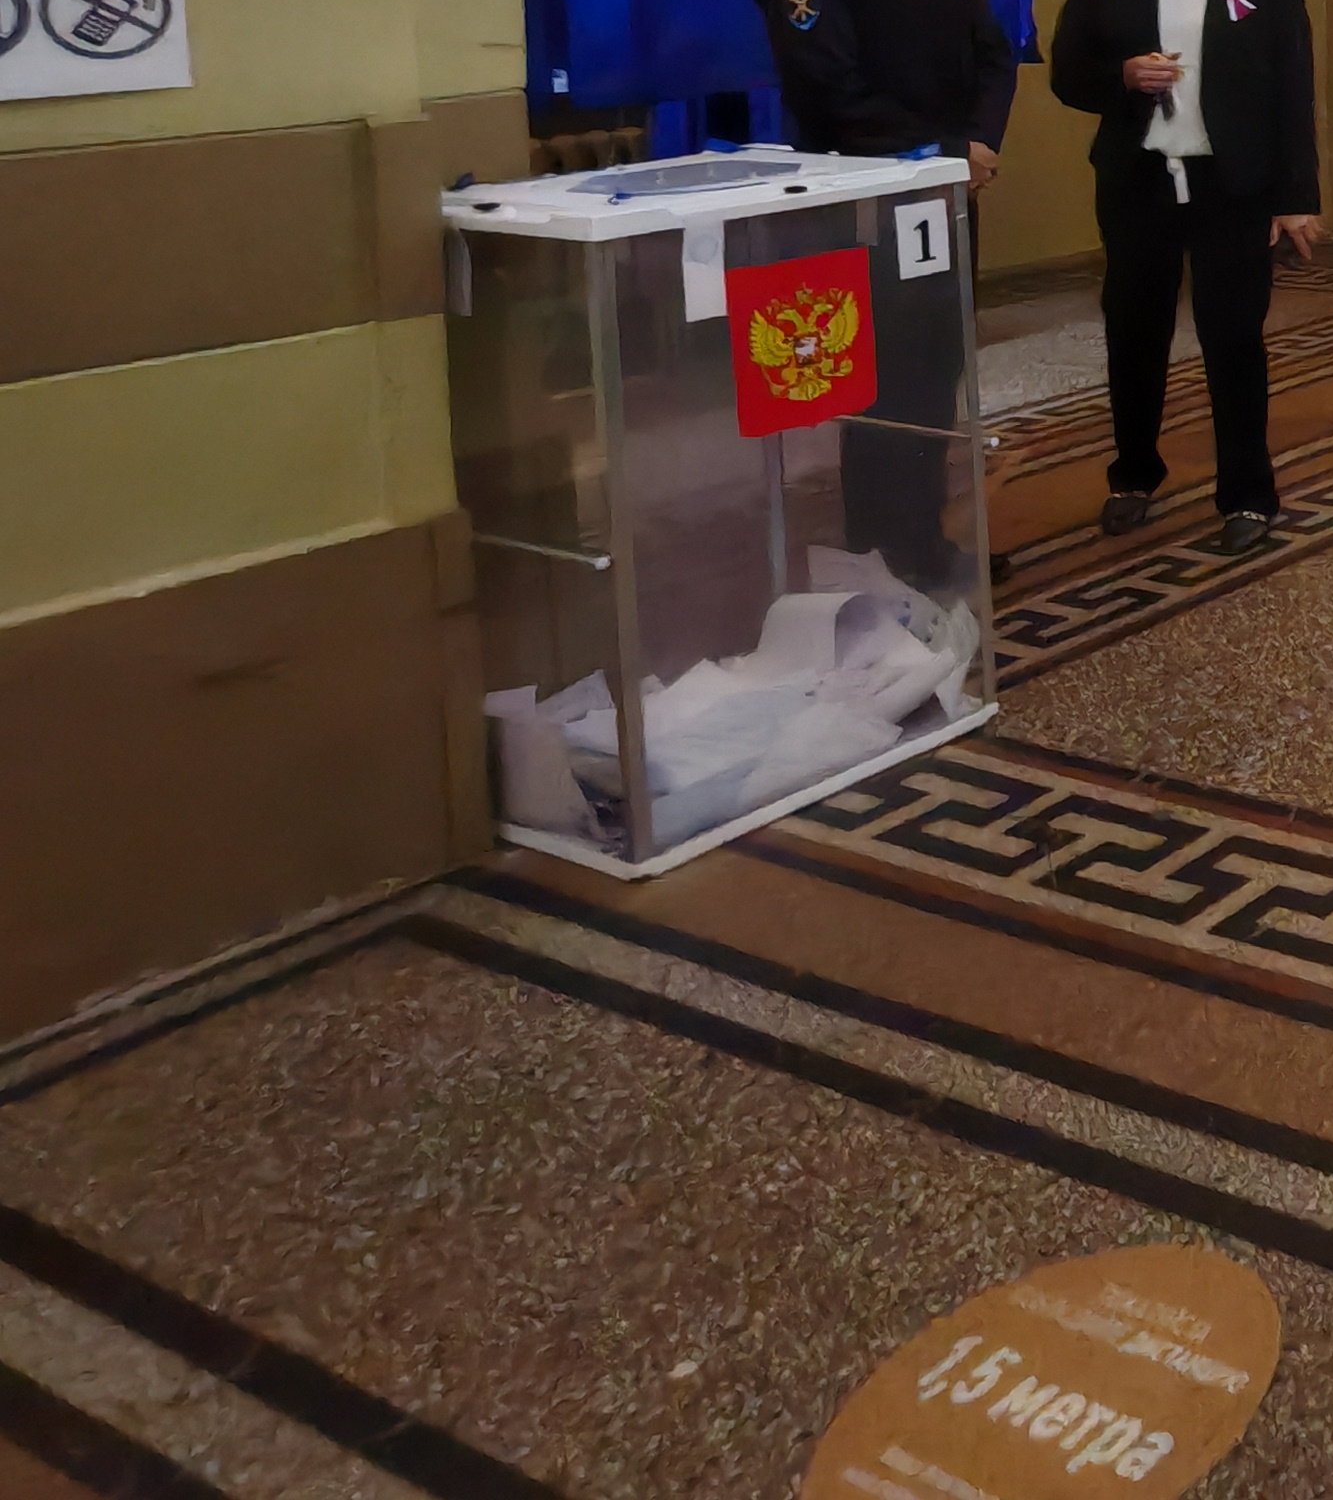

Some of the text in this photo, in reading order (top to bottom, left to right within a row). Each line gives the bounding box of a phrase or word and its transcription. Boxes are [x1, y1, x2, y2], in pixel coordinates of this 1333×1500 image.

[913, 219, 937, 264] 1
[917, 1334, 1024, 1404] 1,5
[986, 1375, 1176, 1482] метра
